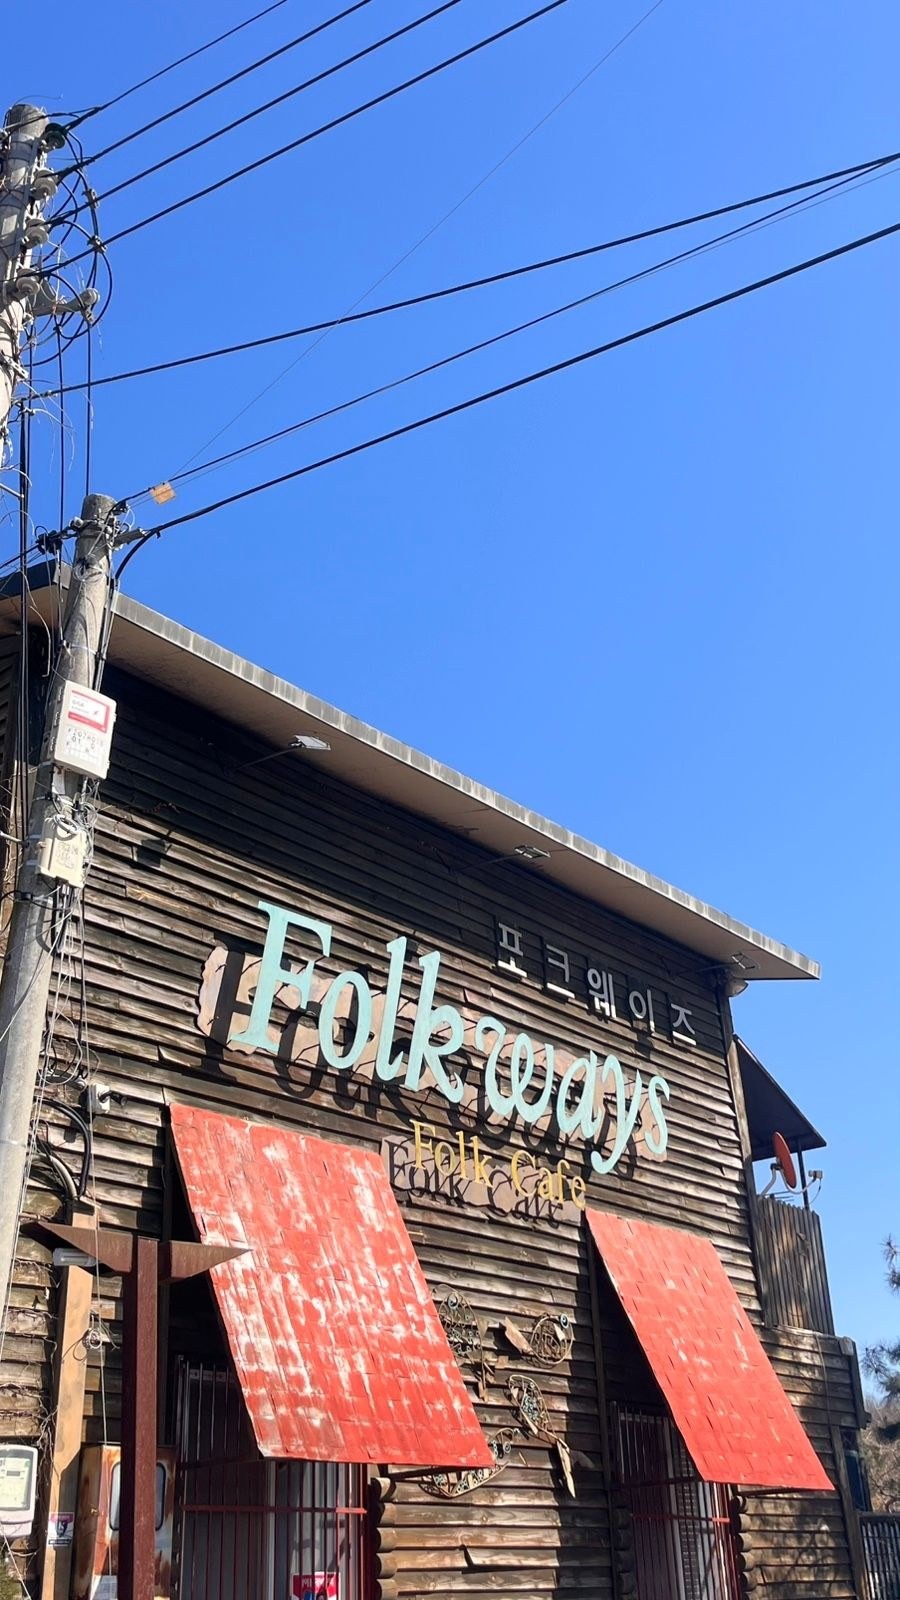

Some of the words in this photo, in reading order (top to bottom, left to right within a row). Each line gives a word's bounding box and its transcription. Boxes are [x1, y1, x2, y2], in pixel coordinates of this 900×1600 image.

[228, 900, 671, 1174] Folkways
[498, 922, 697, 1046] 포크웨이즈
[409, 1119, 493, 1188] Folk
[511, 1150, 587, 1210] Cafe
